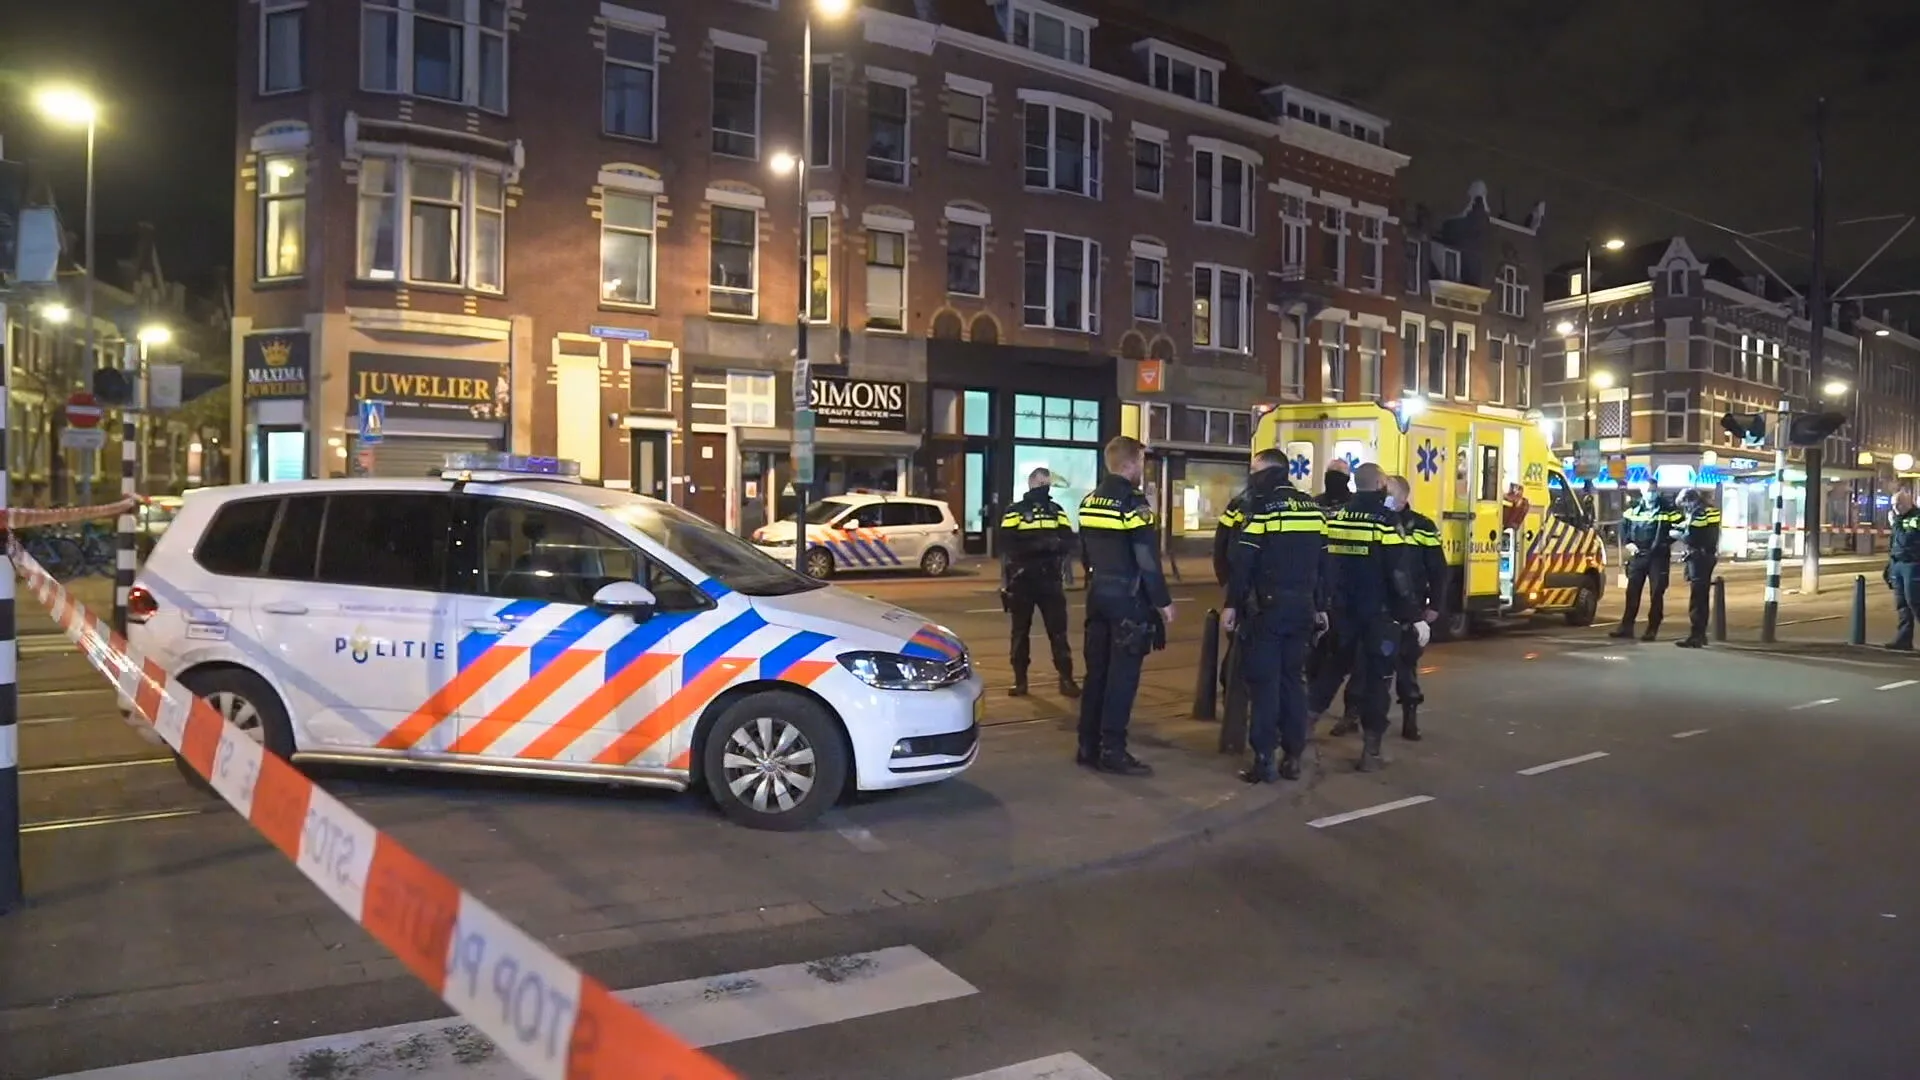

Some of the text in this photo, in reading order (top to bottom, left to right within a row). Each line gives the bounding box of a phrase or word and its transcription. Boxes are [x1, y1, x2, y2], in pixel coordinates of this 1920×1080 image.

[248, 367, 305, 382] MAXIMA
[355, 371, 491, 400] JUWELIER
[810, 380, 902, 410] SIMONS
[818, 407, 889, 418] BEAUTY CENTER
[335, 632, 445, 664] POLITIE
